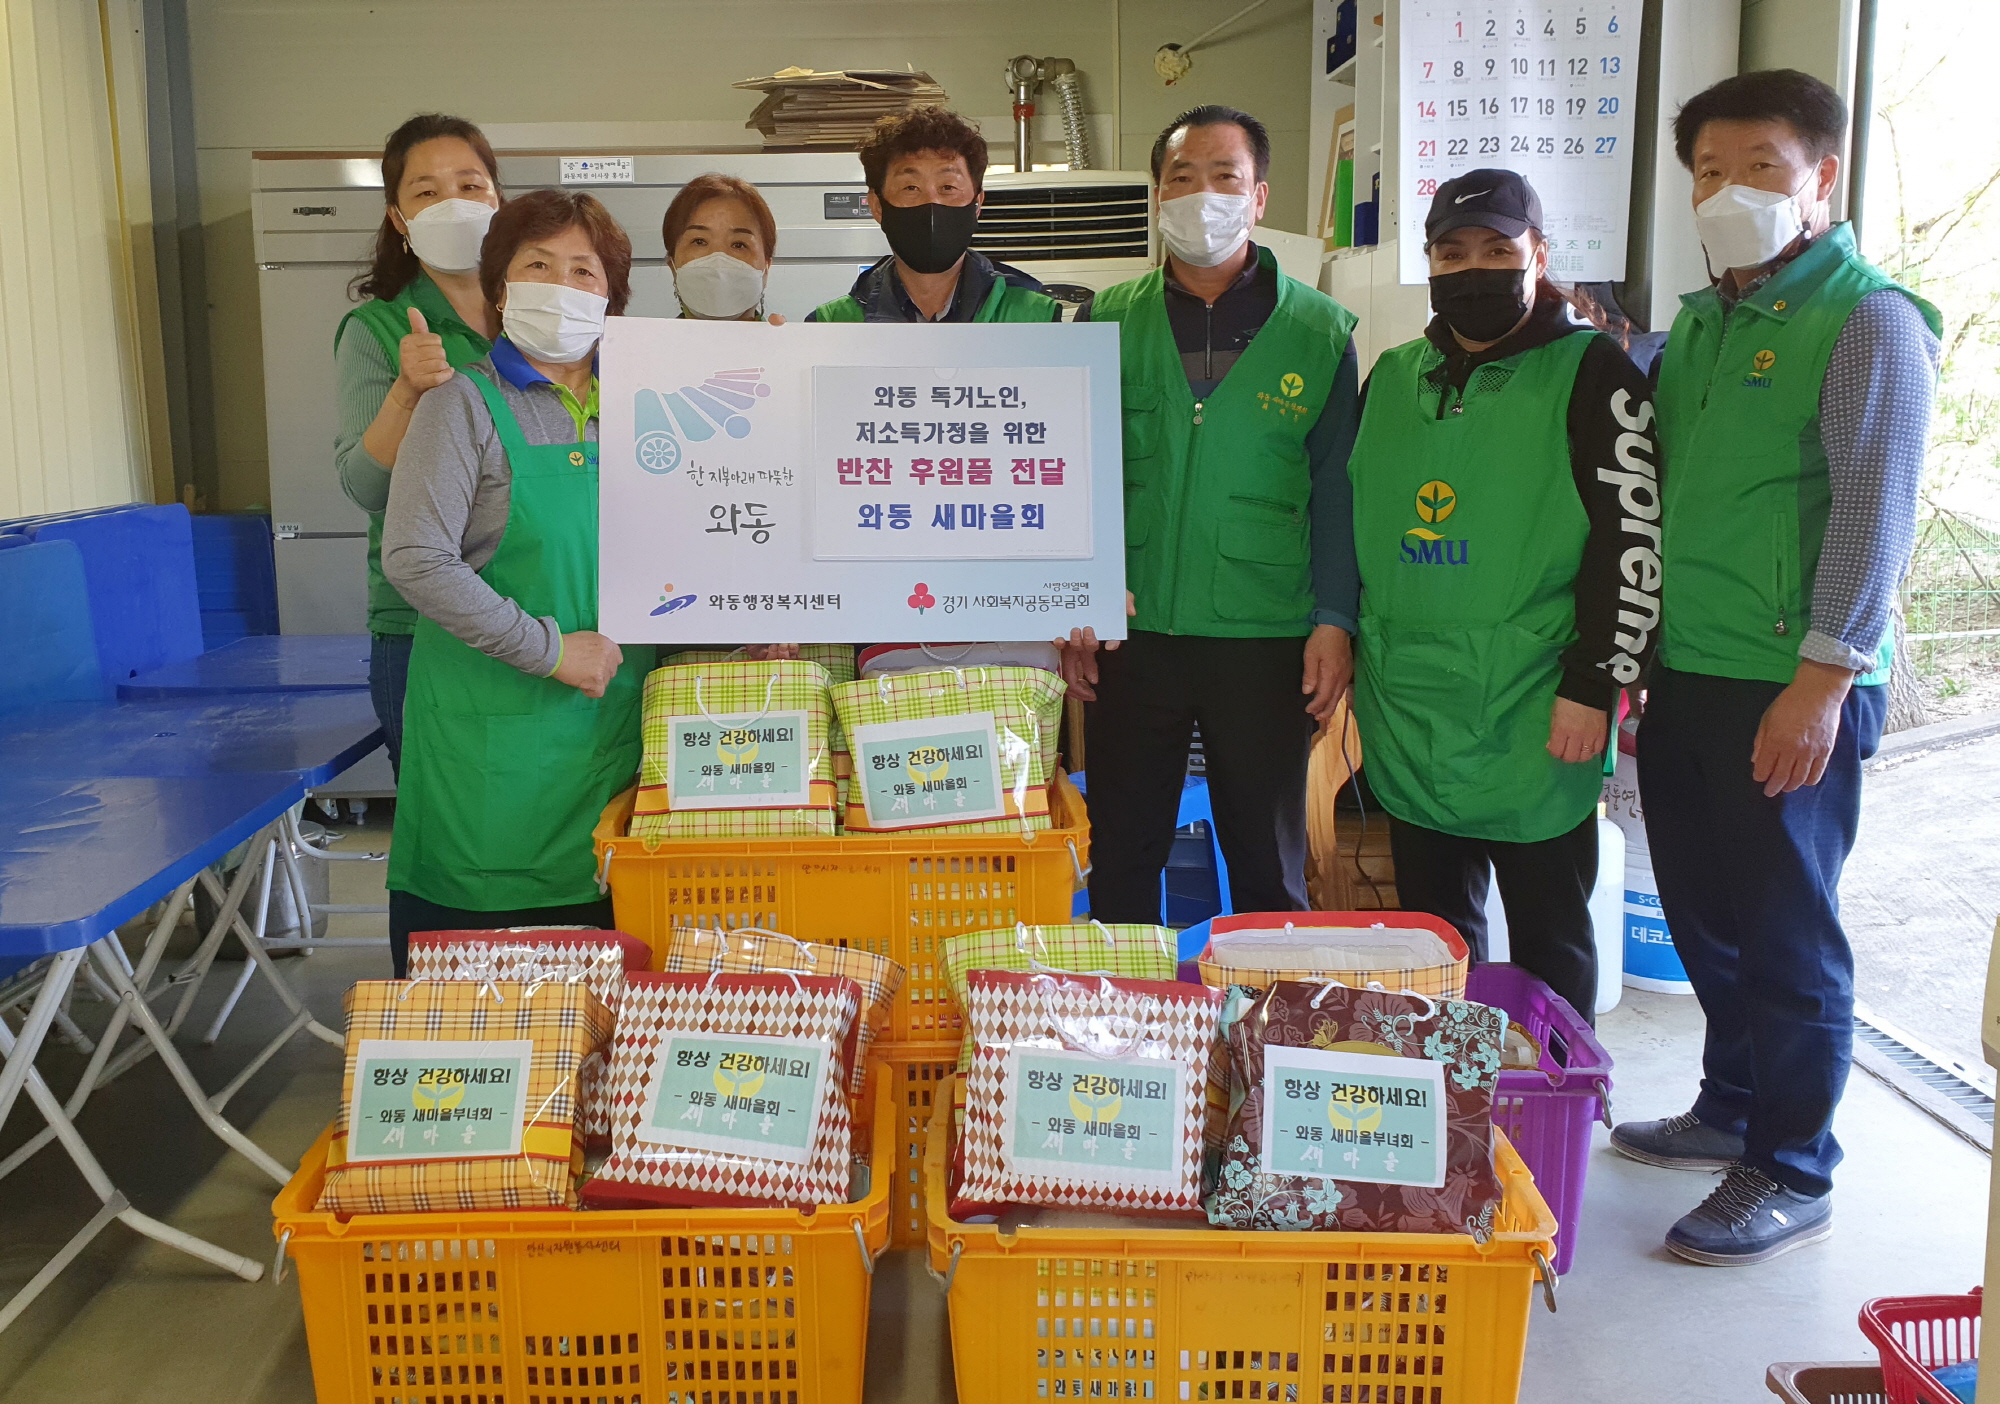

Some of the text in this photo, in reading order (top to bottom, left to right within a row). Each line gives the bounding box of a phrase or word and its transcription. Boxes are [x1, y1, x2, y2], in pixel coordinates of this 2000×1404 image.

[1455, 15, 1618, 38] 1 2 3 4 5 6
[1423, 57, 1620, 78] 7 8 9 10 11 12 13
[1418, 97, 1619, 117] 14 15 16 17 18 19 20
[1418, 136, 1617, 156] 21 22 23 24 25 26 27
[1418, 179, 1436, 195] 28
[1742, 374, 1773, 388] SMU
[874, 385, 1027, 410] 와동 독거노인,
[856, 421, 1047, 445] 저소득가정을 위한
[686, 460, 705, 487] 한
[756, 466, 794, 487] 따뜻한
[837, 457, 1067, 486] 반찬 후원품 전달
[705, 503, 776, 544] 와동
[857, 503, 1045, 531] 와동 새마을회
[1399, 530, 1470, 565] SMU
[1043, 582, 1089, 592] 사랑의열매
[709, 593, 841, 611] 와동행정복지센터
[943, 593, 1090, 614] 경기 사회복지공동모금회
[683, 728, 794, 747] 항상 건강하세요!
[701, 762, 775, 776] 와동 새마을회
[872, 745, 983, 770] 항상 건강하세요!
[894, 777, 967, 795] 와동 새마을회
[677, 1050, 810, 1078] 항상 건강하세요!
[374, 1068, 511, 1086] 항상 건강하세요!
[1028, 1070, 1167, 1100] 항상 건강하세요!
[689, 1091, 780, 1116] 와동 새마을회
[1284, 1079, 1427, 1108] 항상 건강하세요!
[380, 1108, 493, 1123] 와동 새마을부녀회
[1048, 1117, 1141, 1140] 와동 새마을회
[1296, 1126, 1413, 1149] 와동 새마을부녀회
